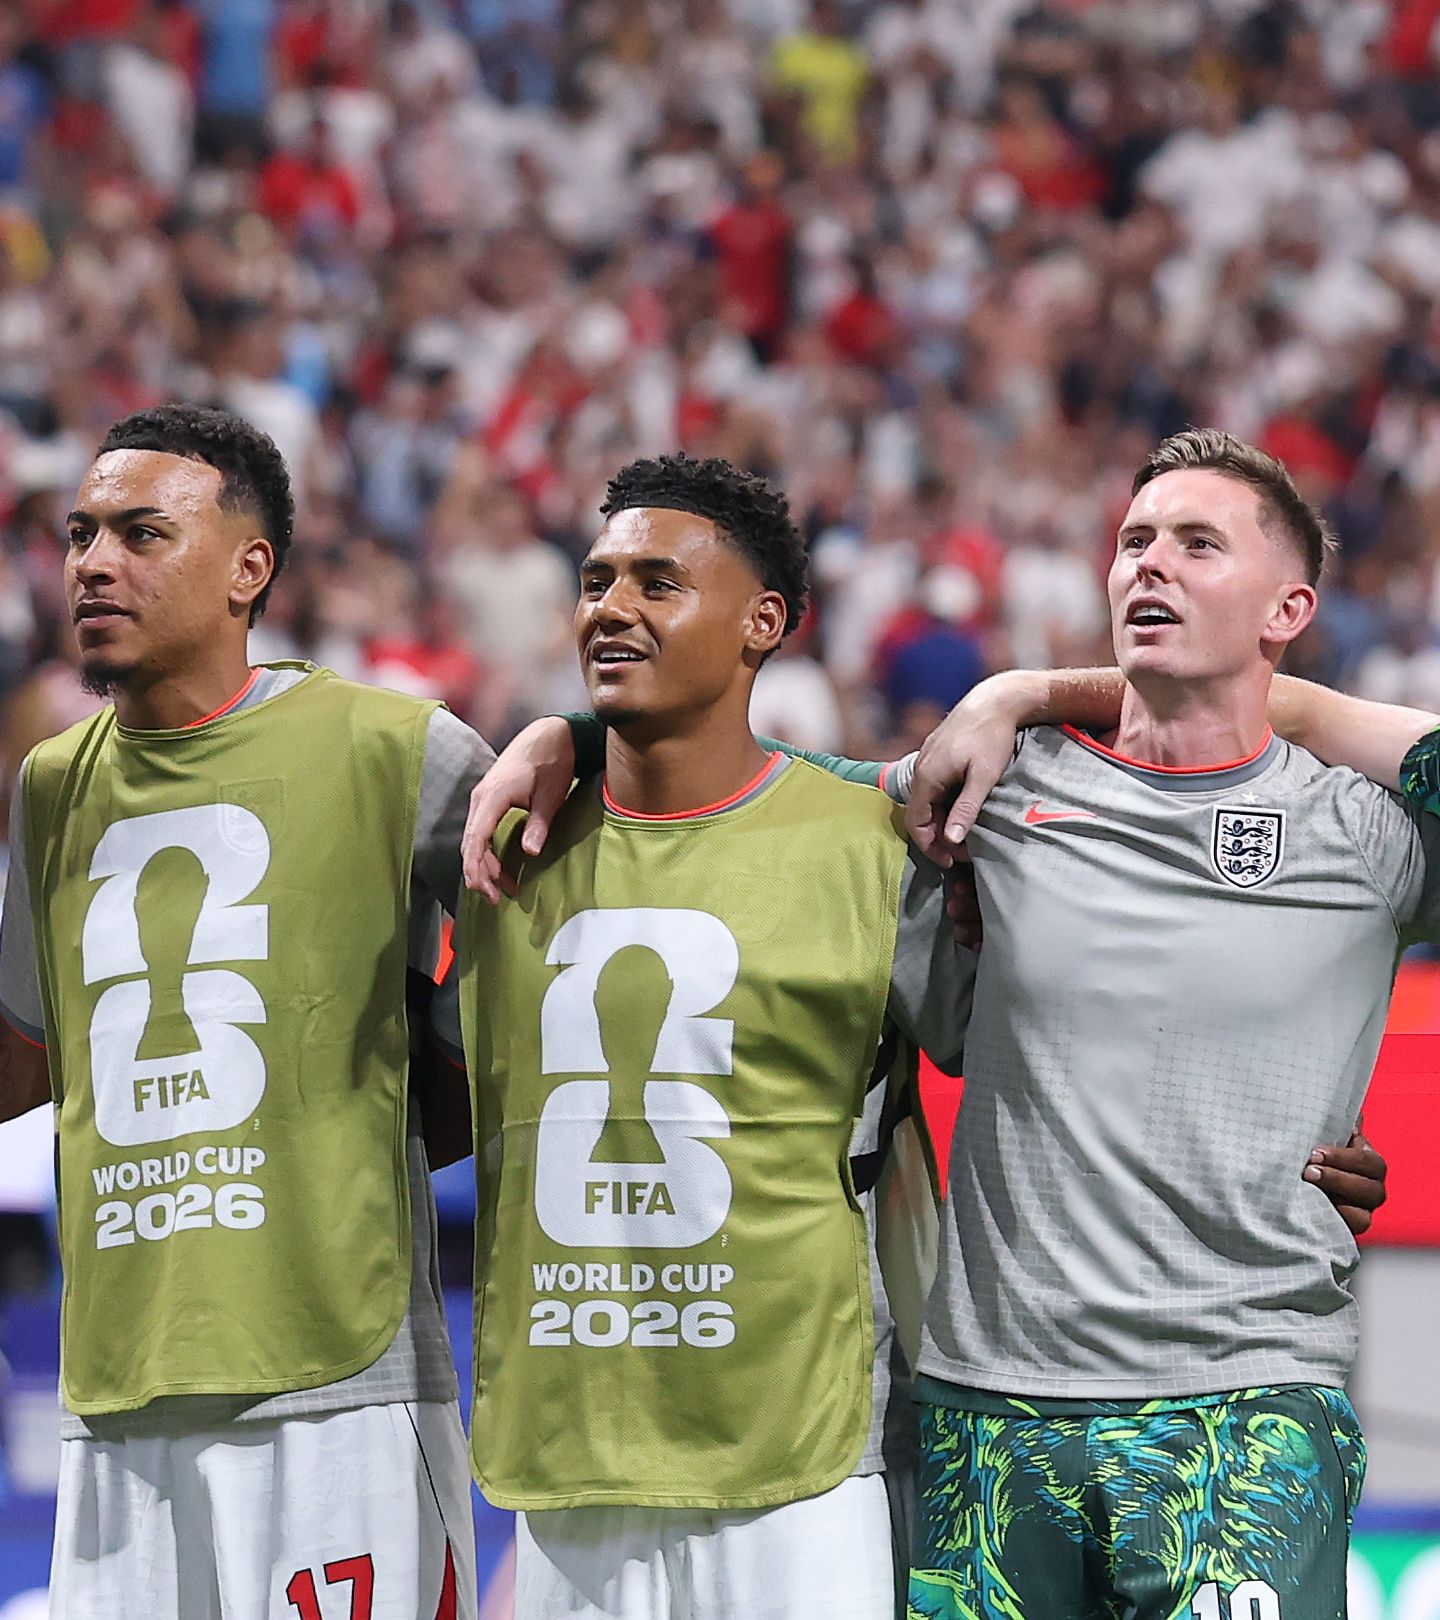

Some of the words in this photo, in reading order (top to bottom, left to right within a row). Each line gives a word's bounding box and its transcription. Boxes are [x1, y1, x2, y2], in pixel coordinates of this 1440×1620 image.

[133, 1069, 211, 1113] FIFA
[92, 1150, 191, 1196] WORLD
[194, 1146, 267, 1176] CUP
[94, 1181, 266, 1250] 2026
[584, 1181, 676, 1215] FIFA
[532, 1263, 656, 1292] WORLD
[660, 1263, 735, 1293] CUP
[528, 1299, 737, 1348] 2026
